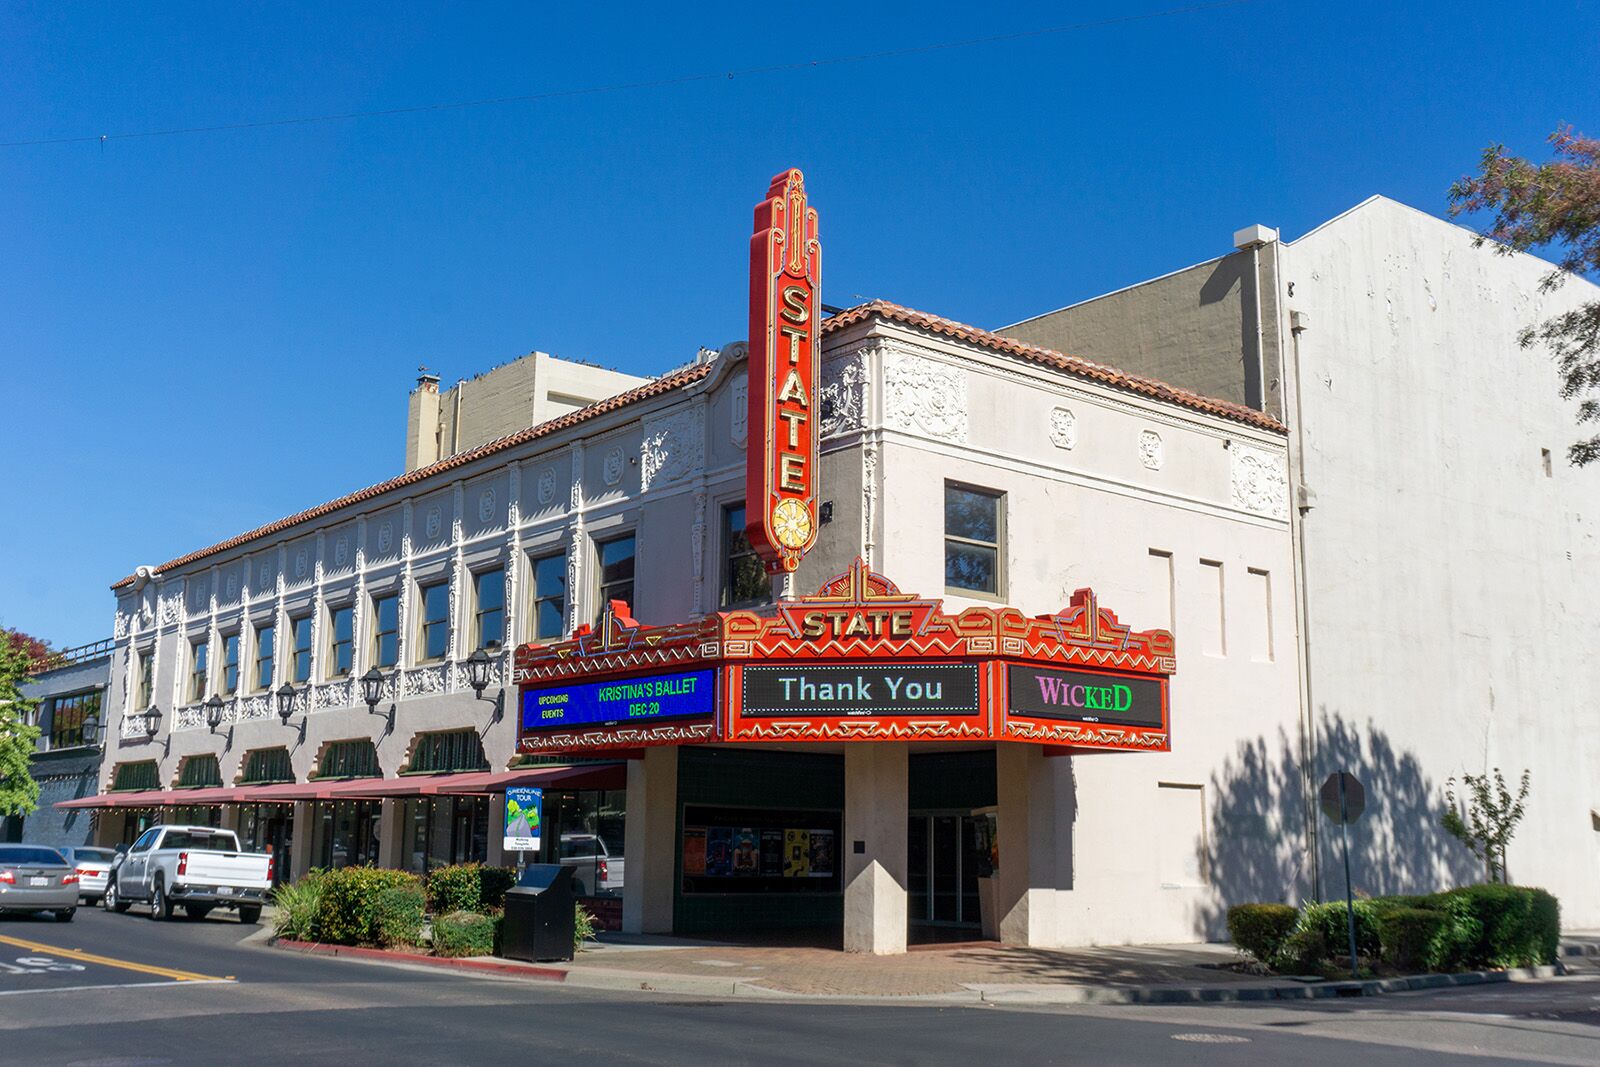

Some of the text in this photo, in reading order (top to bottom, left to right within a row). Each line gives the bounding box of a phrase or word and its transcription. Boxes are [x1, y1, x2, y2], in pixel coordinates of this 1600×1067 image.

[777, 285, 809, 493] STATE
[803, 610, 914, 637] STATE
[538, 694, 569, 705] UPCOMING
[598, 677, 698, 702] KRISTINA'S BALLET
[778, 676, 942, 701] Thank You
[541, 709, 564, 719] EVENTS
[629, 702, 660, 716] DEC 20
